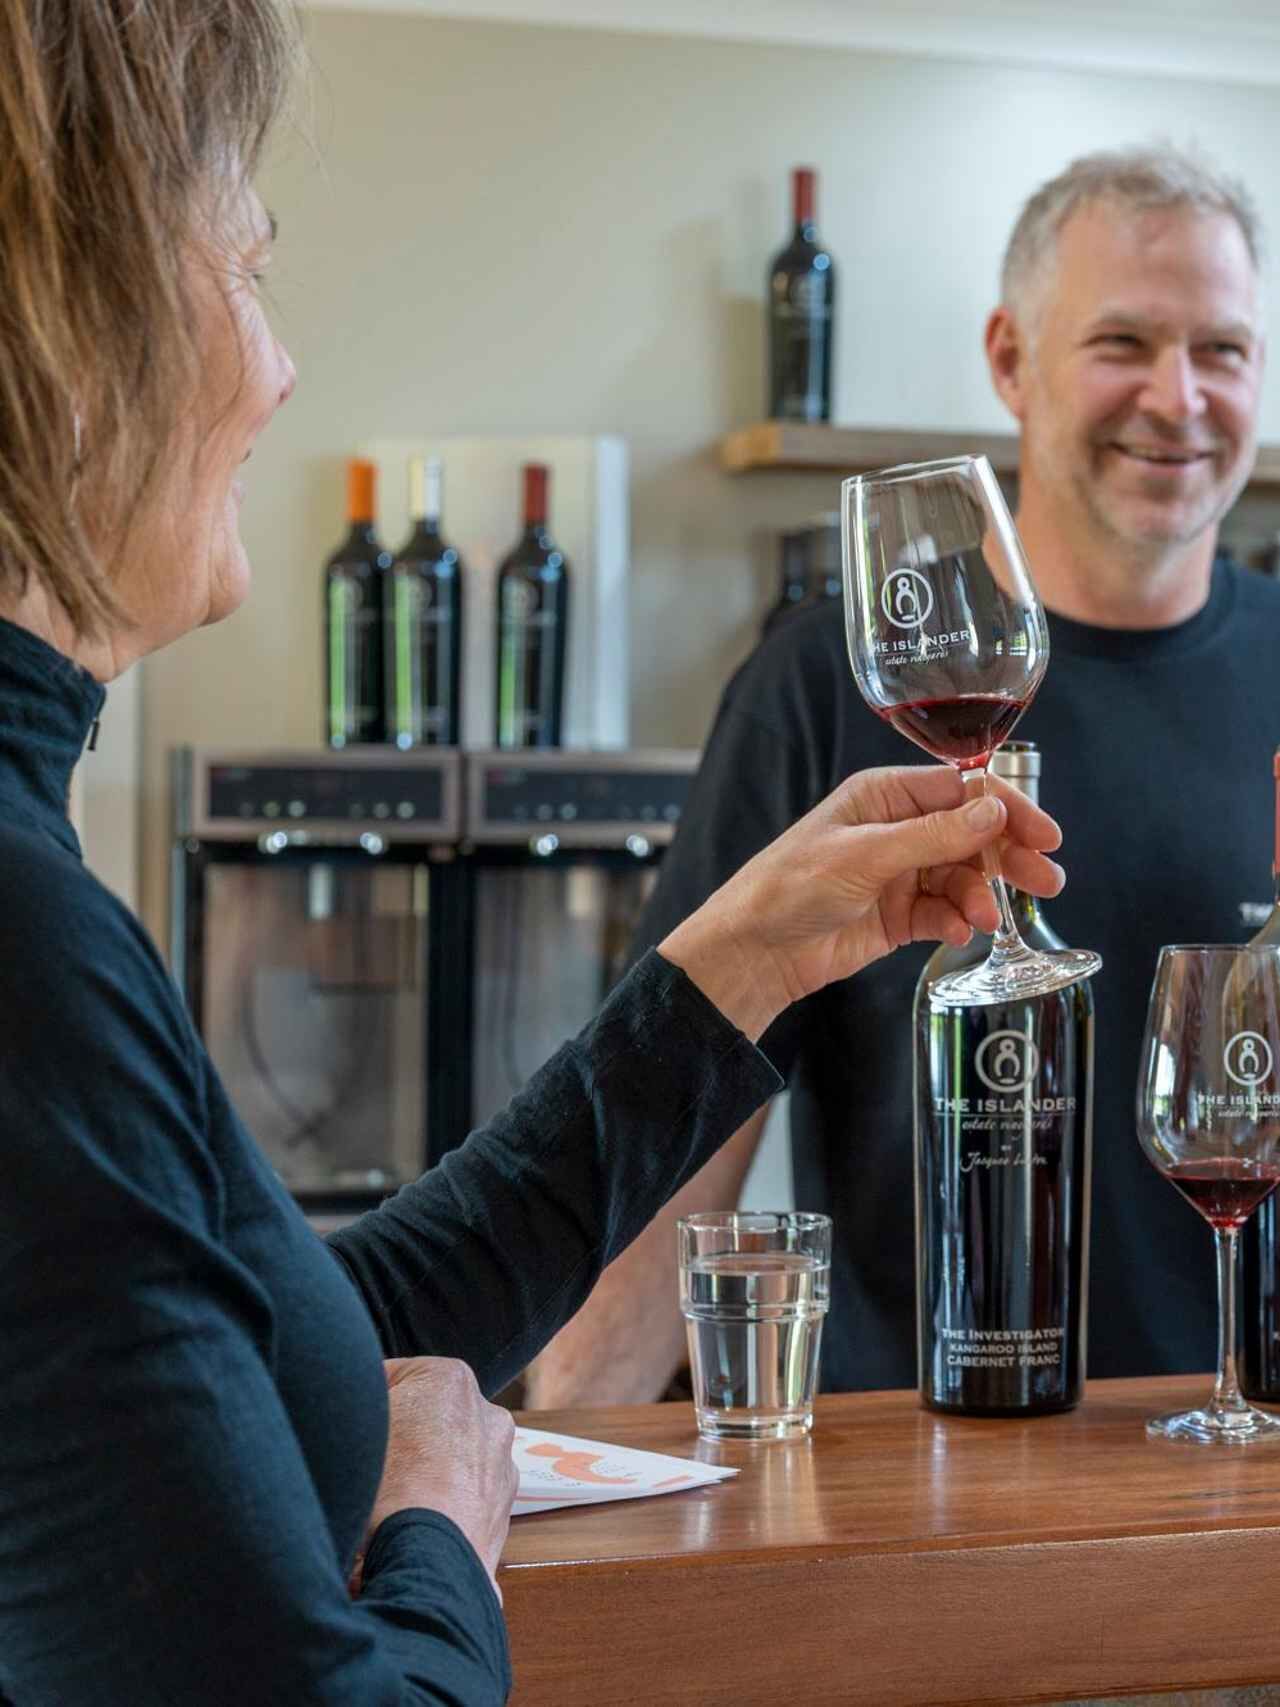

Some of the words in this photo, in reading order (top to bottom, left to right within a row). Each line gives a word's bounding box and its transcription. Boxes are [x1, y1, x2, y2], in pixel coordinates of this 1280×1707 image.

[935, 1097, 970, 1112] THE
[978, 1097, 1077, 1112] ISLANDER
[1198, 1094, 1225, 1105] HE
[942, 1328, 966, 1339] THE
[950, 1343, 1015, 1354] KANGAROO
[1018, 1342, 1059, 1353] ISLAND
[946, 1354, 1016, 1367] CABERNET
[1019, 1354, 1061, 1366] FRANC
